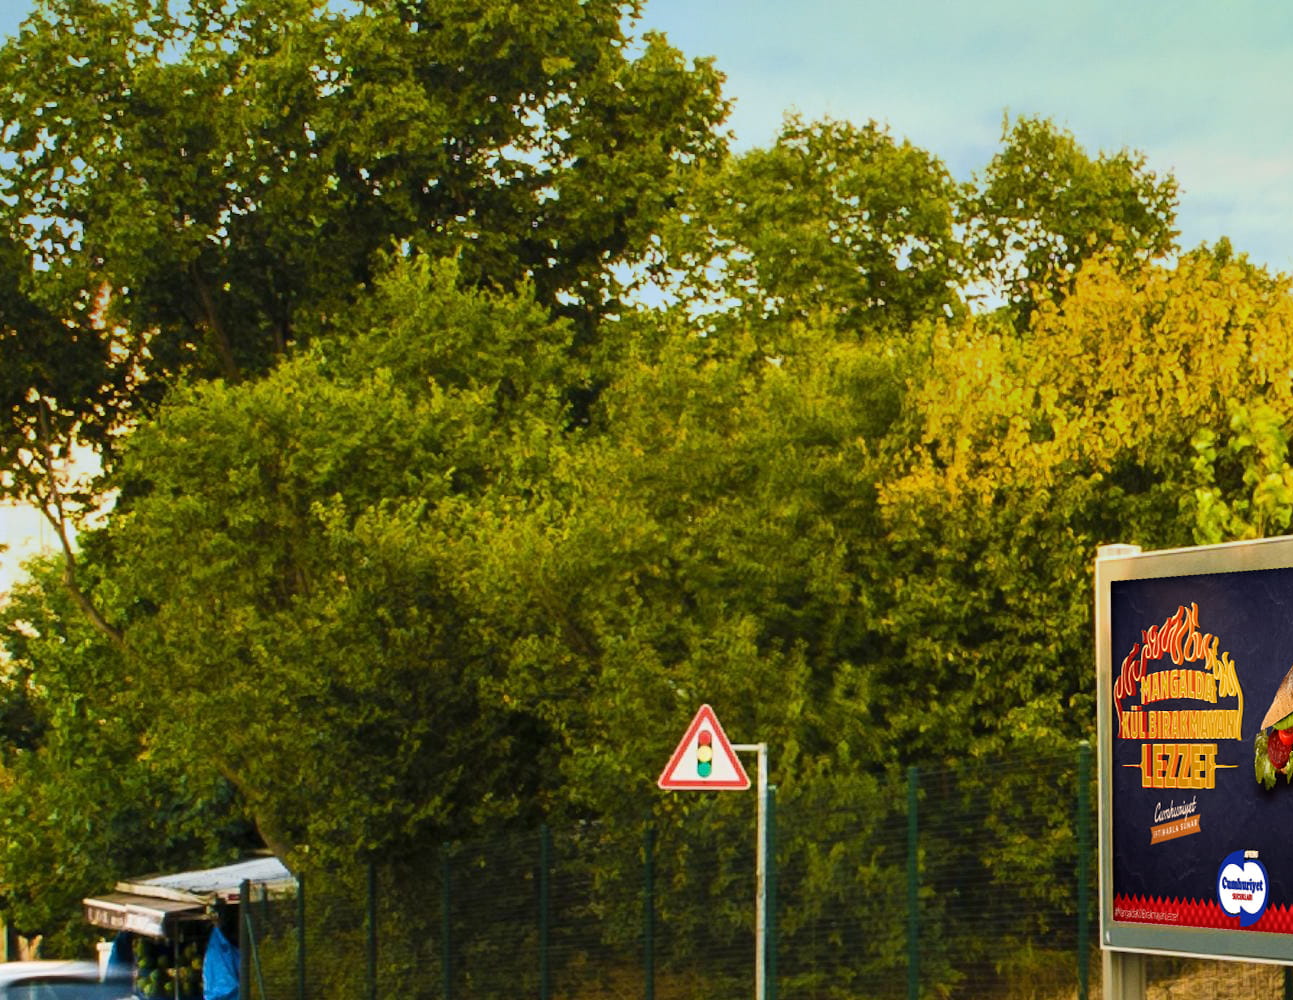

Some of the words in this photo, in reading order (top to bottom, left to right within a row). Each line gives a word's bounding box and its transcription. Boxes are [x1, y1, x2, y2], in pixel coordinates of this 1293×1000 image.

[1140, 669, 1217, 704] MANGALDA
[1121, 705, 1149, 739] KÜL
[1149, 710, 1239, 739] BIRAKMAYAN
[1140, 743, 1218, 789] LEZZET
[1222, 876, 1263, 892] Cumhuriyet
